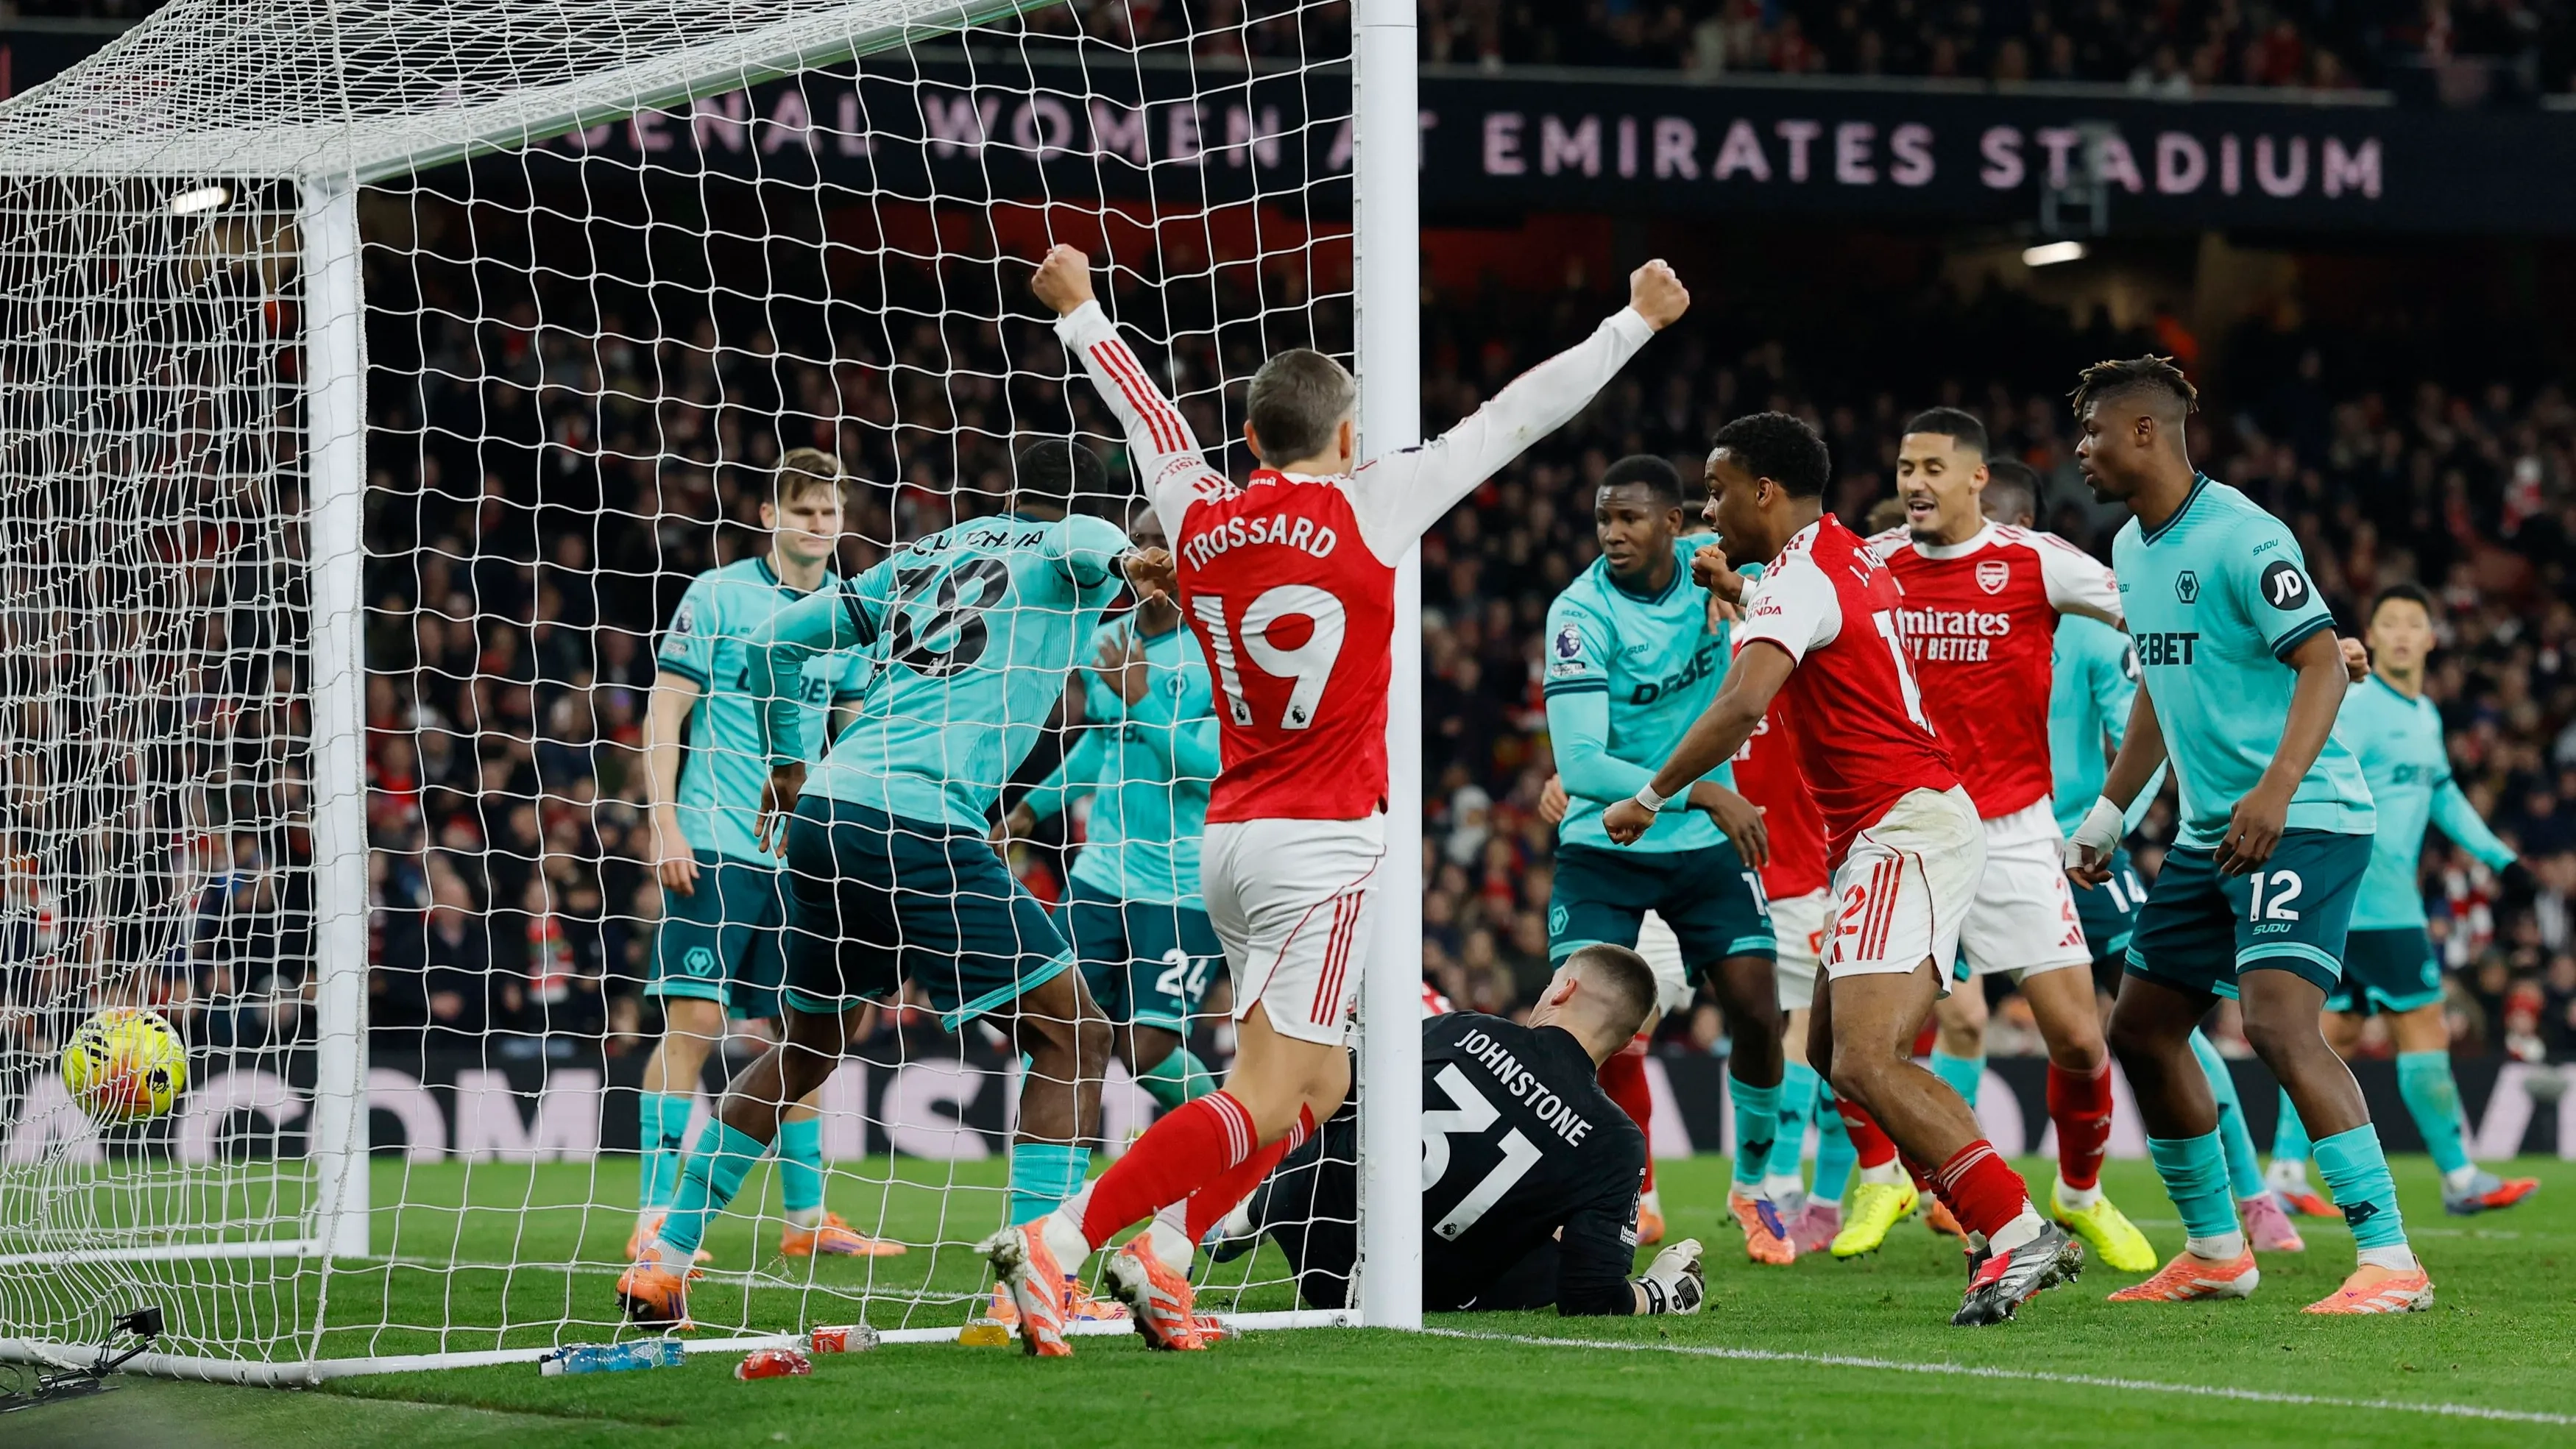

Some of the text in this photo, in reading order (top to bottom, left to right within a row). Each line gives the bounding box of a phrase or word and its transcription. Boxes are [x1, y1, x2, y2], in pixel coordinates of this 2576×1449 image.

[923, 96, 1281, 168] WOMEN
[1483, 113, 1936, 187] EMIRATES
[1980, 127, 2384, 198] STADIUM
[1183, 514, 1337, 572] TROSSARD
[2253, 539, 2278, 556] SUDU
[2273, 569, 2303, 606] JD
[1903, 606, 2011, 636] mirates
[1191, 584, 1346, 730] 19
[1927, 637, 1989, 662] BETTER
[2134, 633, 2199, 665] EBET
[2249, 870, 2302, 922] 12
[2252, 924, 2292, 935] SUDU
[1155, 947, 1209, 1004] 24
[1453, 1028, 1593, 1148] JOHNSTONE
[1421, 1061, 1544, 1242] 31
